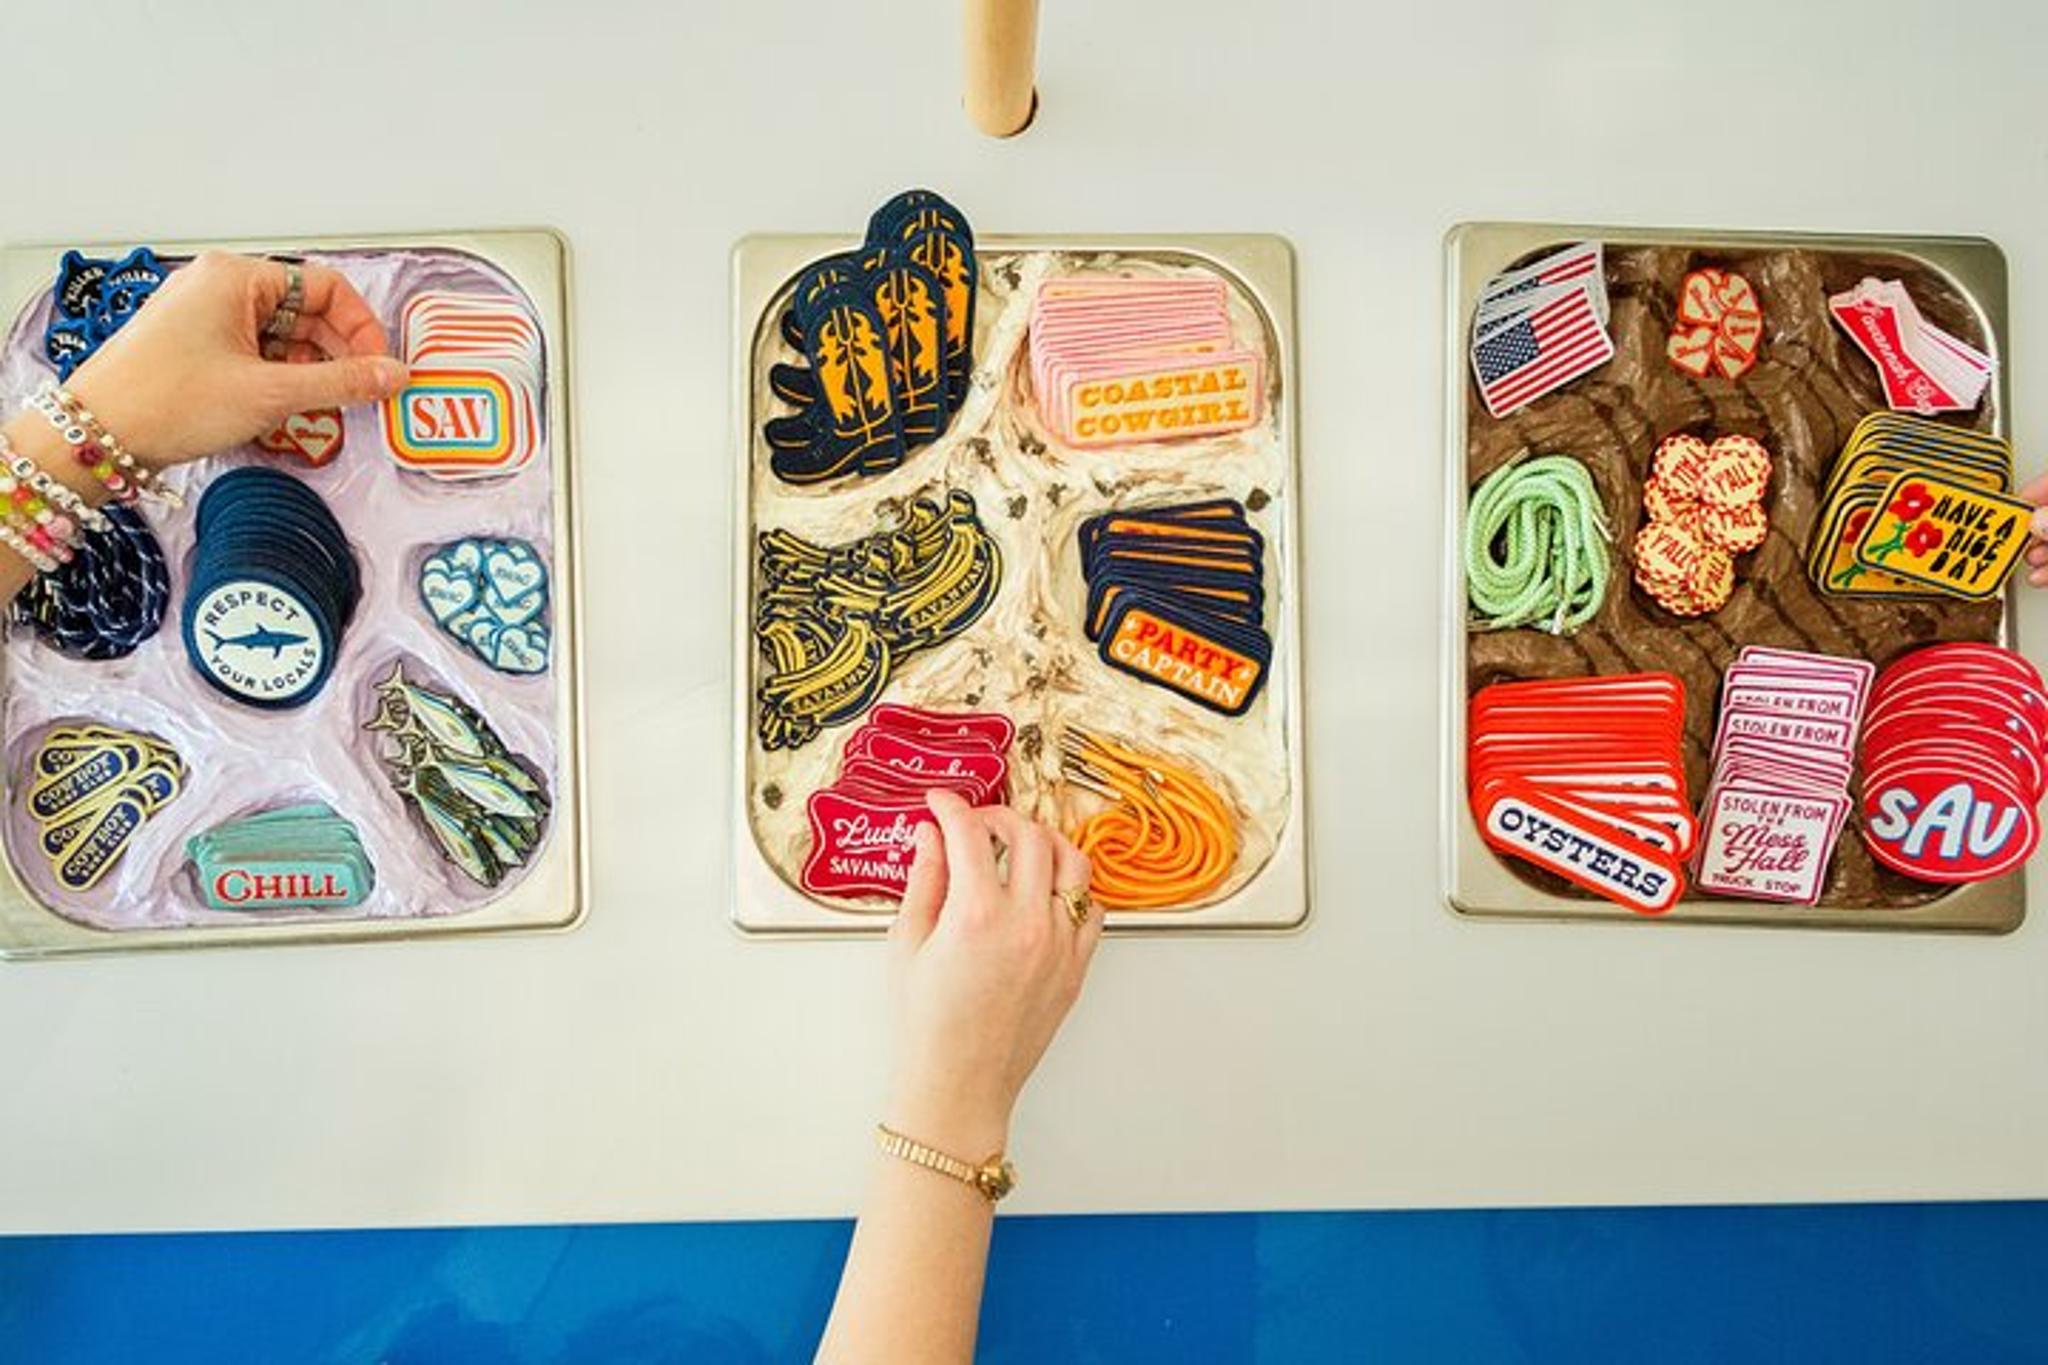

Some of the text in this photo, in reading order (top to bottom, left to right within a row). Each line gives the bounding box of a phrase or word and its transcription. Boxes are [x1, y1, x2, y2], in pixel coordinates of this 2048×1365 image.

[1078, 368, 1247, 407] COASTAL
[410, 396, 488, 439] SAV
[1075, 400, 1249, 438] COWGIRL
[1931, 494, 2017, 540] HAVE A
[1945, 527, 2005, 562] NICE
[1929, 551, 1989, 585] DAY
[203, 590, 300, 627] RESPECT
[908, 558, 985, 630] SAVANNAH
[1135, 618, 1246, 682] PARTY
[211, 647, 317, 692] YOUR LOCALS
[791, 657, 875, 710] SAVANNAH
[1115, 638, 1242, 706] CAPTAIN
[1797, 697, 1843, 715] FROM
[1731, 718, 1839, 742] STOLEN FROM
[1722, 796, 1827, 822] STOLEN FROM
[1870, 781, 2022, 860] SAV
[832, 813, 917, 854] Lucky
[1499, 807, 1668, 897] OYSTERS
[1721, 821, 1808, 849] Mess
[829, 856, 908, 882] SAVANNA
[1722, 847, 1811, 874] Hall
[214, 869, 348, 904] CHILL
[1765, 879, 1802, 893] STOP
